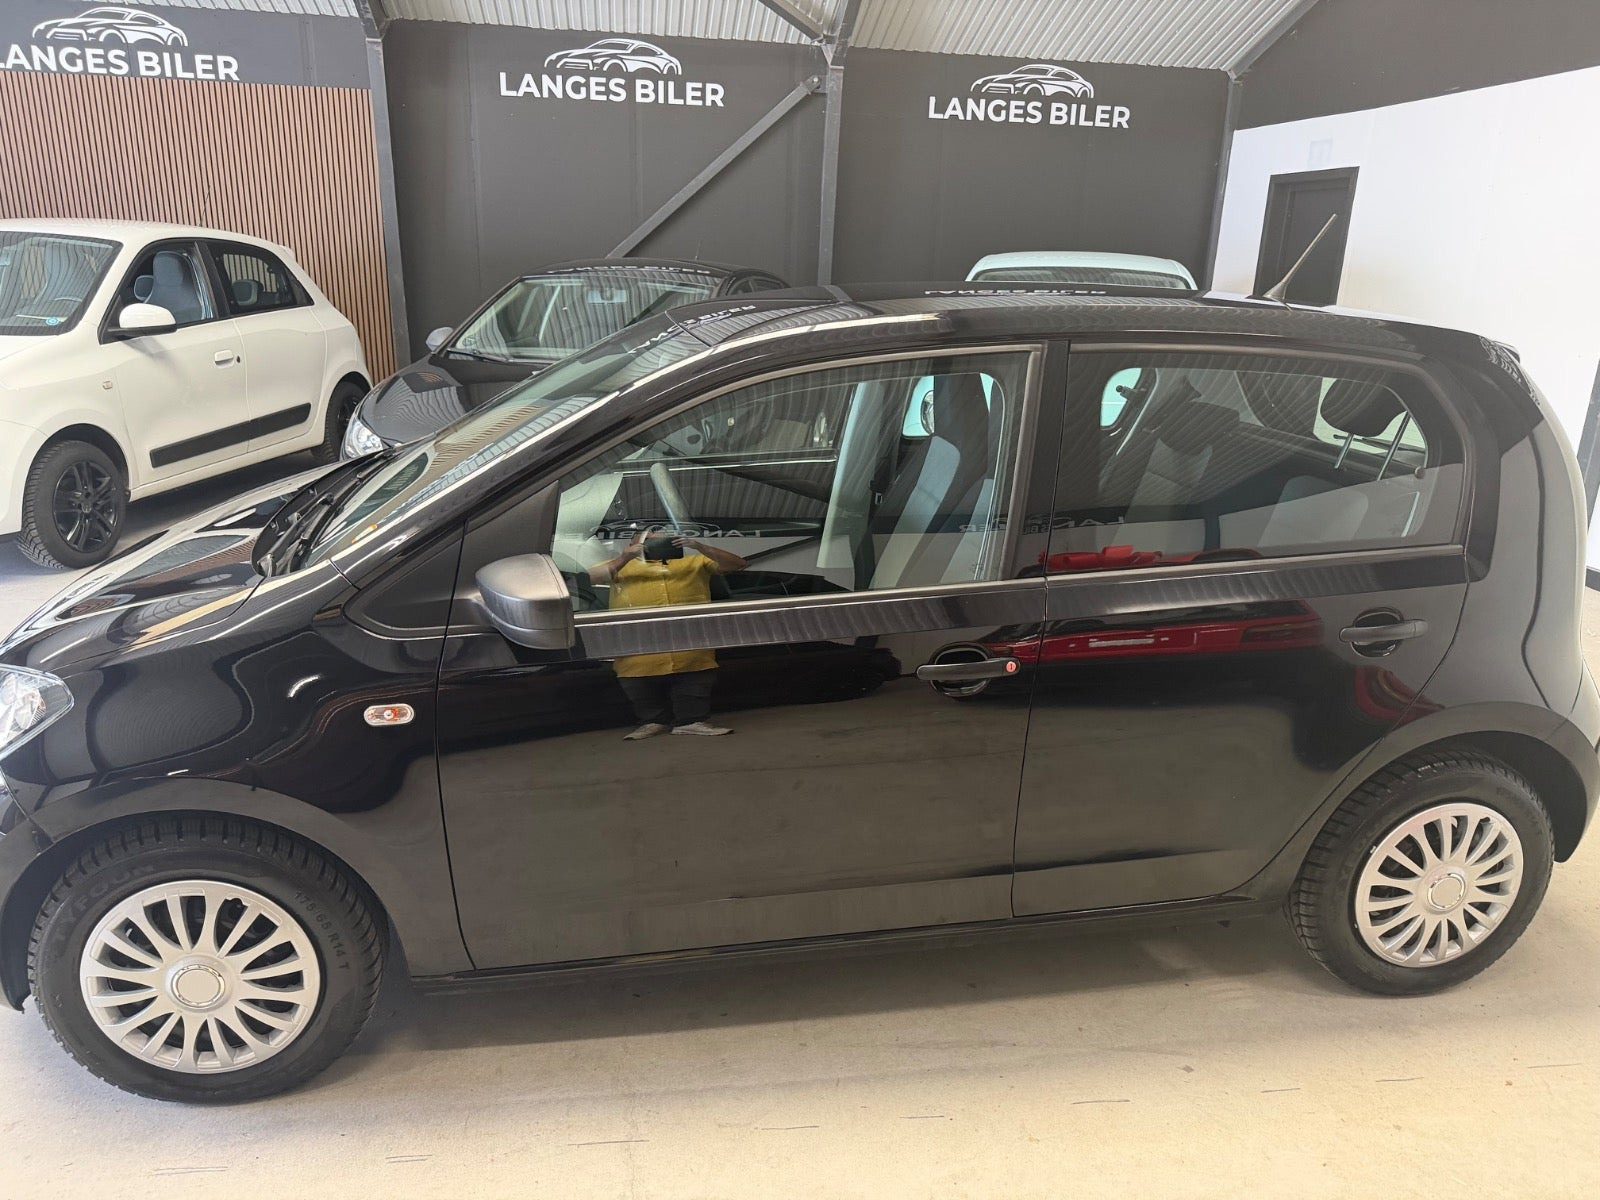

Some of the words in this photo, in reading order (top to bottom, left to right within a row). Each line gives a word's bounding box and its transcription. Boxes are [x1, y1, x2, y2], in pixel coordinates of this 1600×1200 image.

[0, 44, 129, 76] ANGES
[137, 51, 240, 81] BILER
[499, 71, 627, 102] LANGES
[635, 78, 725, 107] BILER
[928, 96, 1043, 124] LANGES
[1049, 102, 1131, 129] BILER
